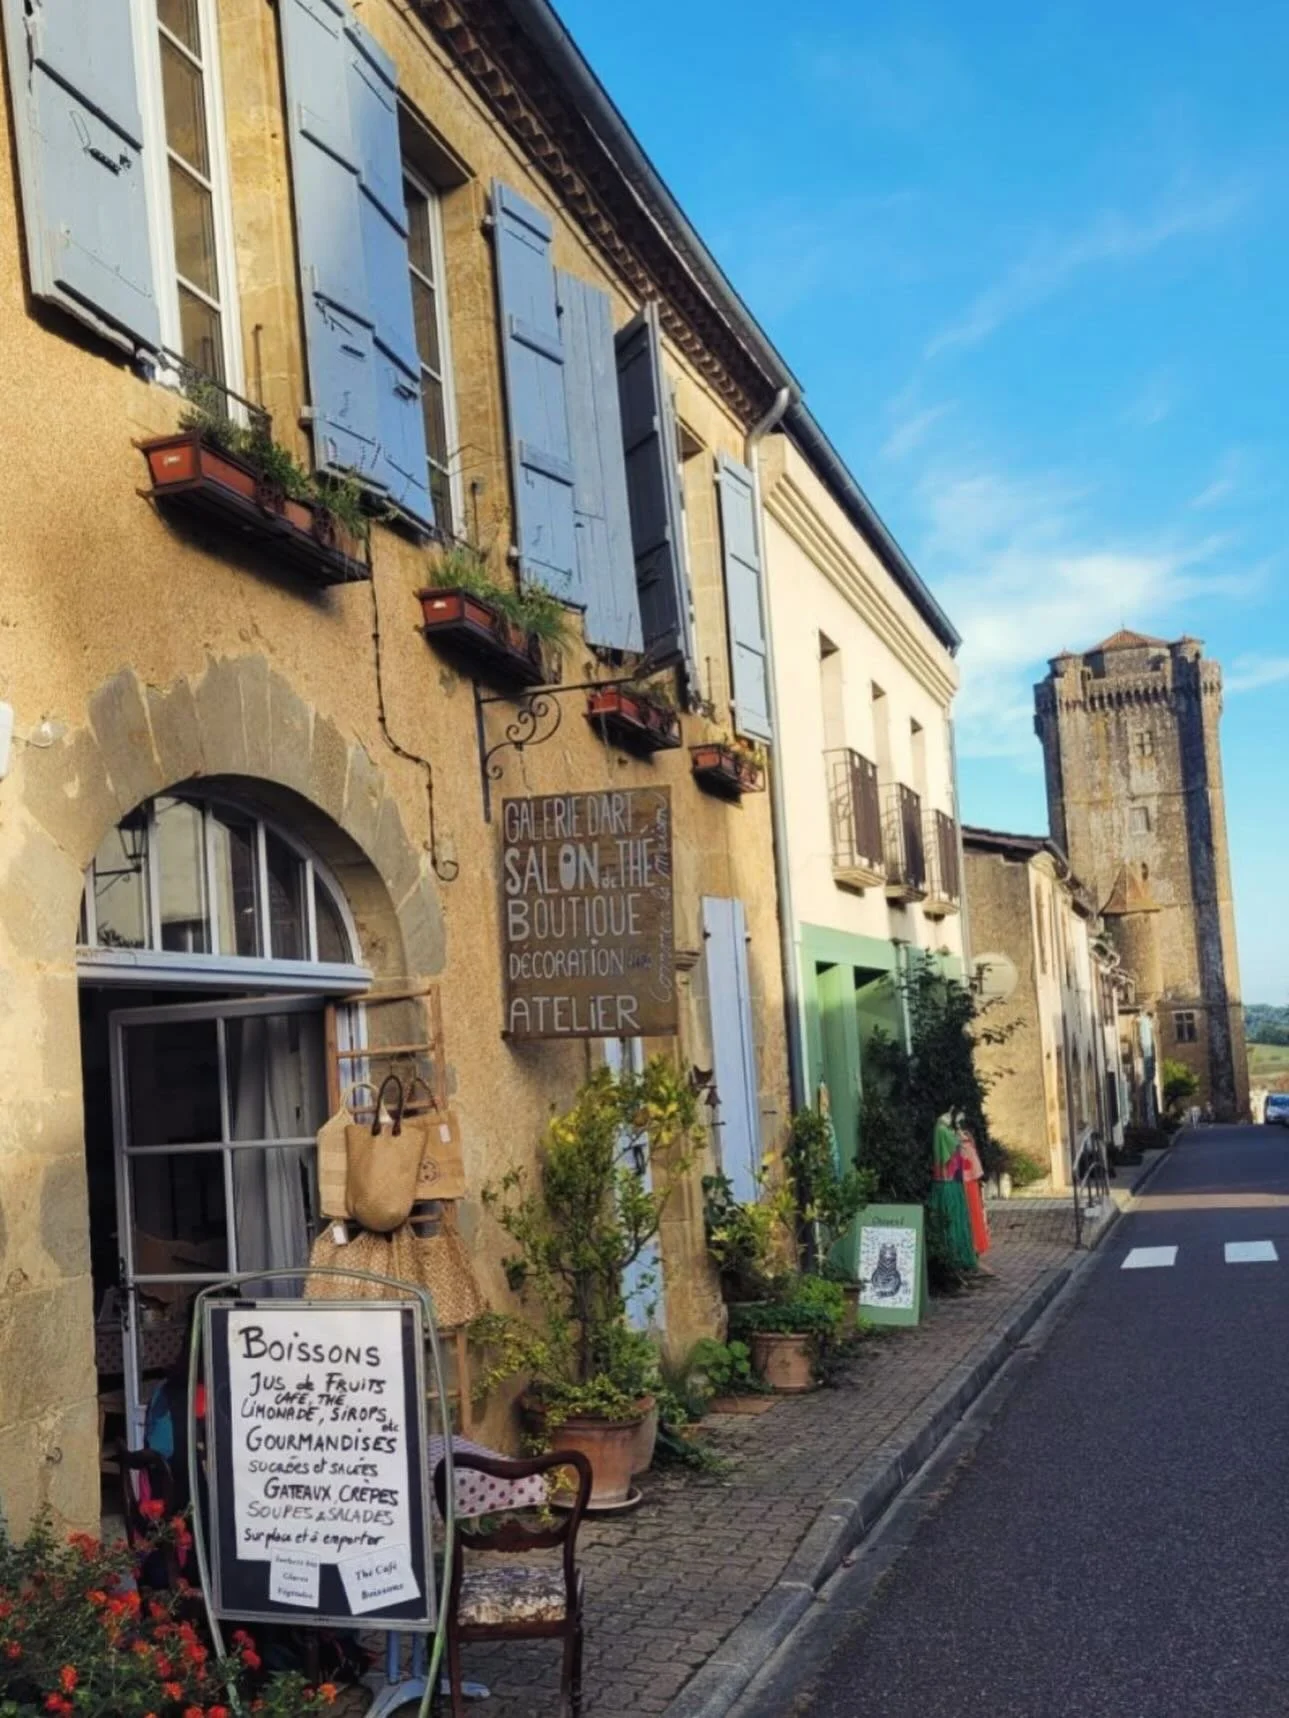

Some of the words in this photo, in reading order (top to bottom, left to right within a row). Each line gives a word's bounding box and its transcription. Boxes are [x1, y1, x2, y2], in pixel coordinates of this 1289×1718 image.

[504, 795, 583, 844] GALERIE
[504, 842, 599, 896] SALON
[616, 824, 655, 888] THÉ
[507, 893, 643, 942] BOUTIQUE
[312, 1457, 327, 1474] et
